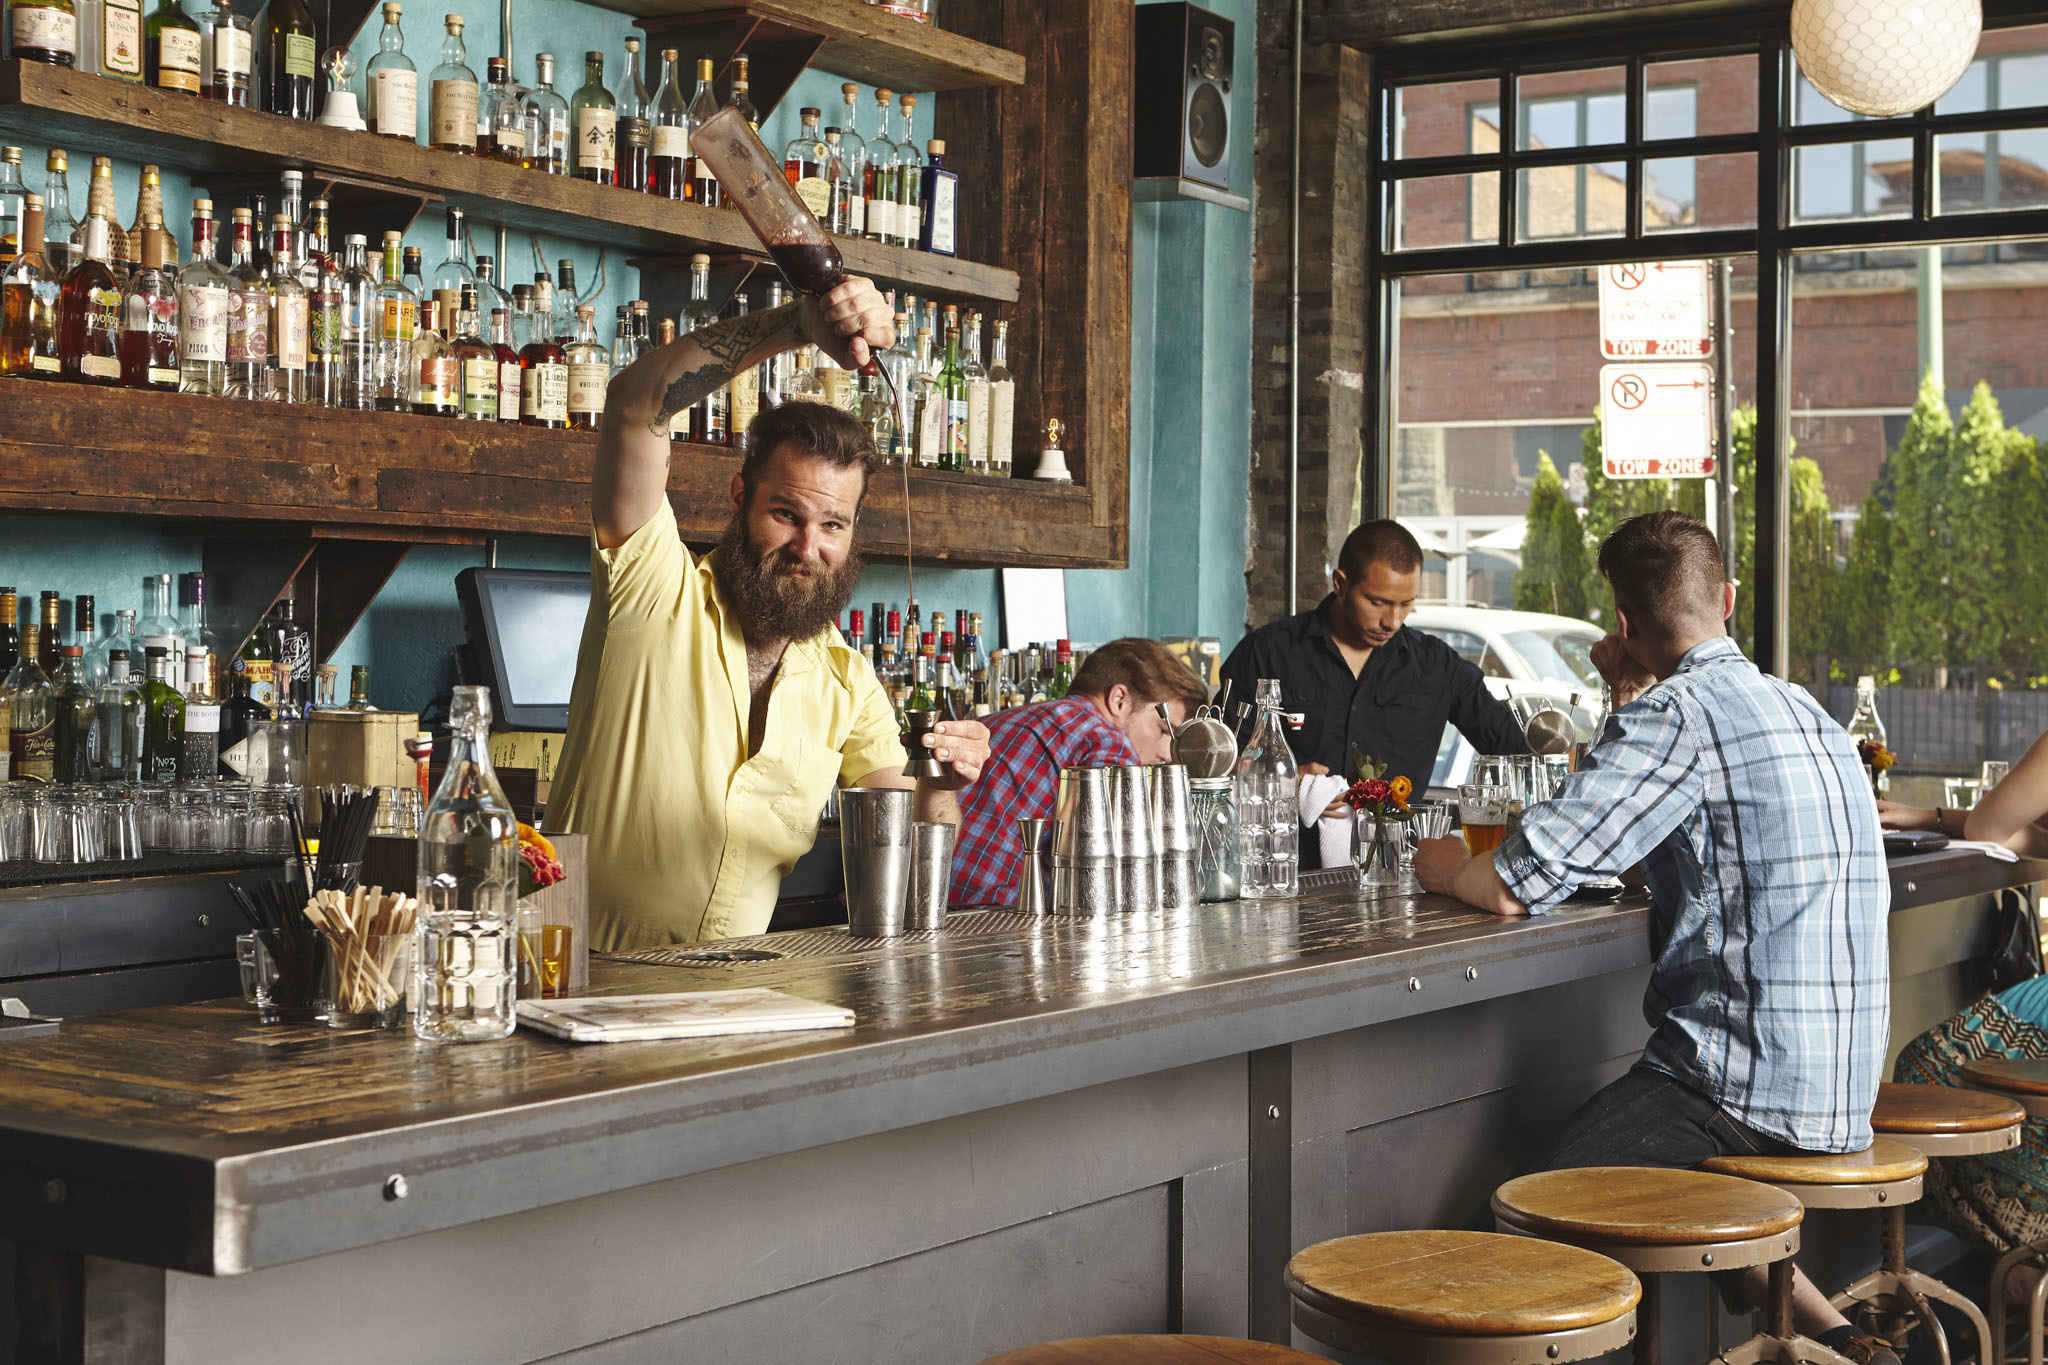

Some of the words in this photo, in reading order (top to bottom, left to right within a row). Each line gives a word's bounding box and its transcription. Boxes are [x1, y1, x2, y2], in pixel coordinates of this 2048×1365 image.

[1611, 341, 1648, 355] TOW
[1655, 339, 1702, 354] ZONE
[1613, 460, 1650, 474] TOW
[1658, 458, 1705, 473] ZONE
